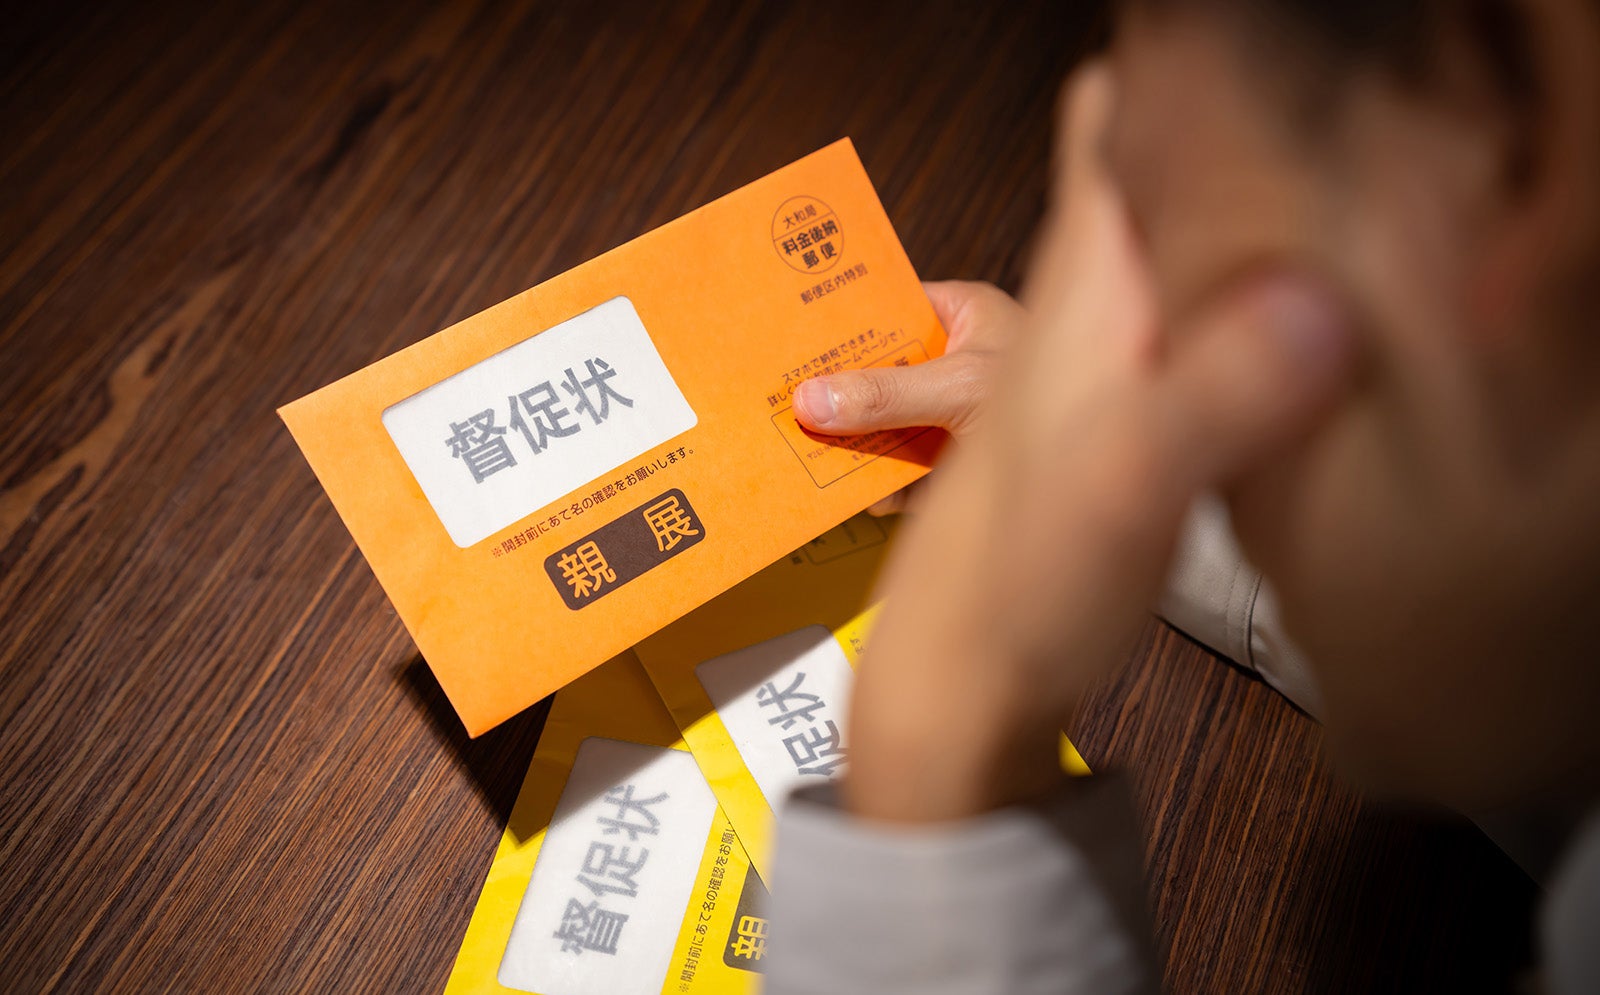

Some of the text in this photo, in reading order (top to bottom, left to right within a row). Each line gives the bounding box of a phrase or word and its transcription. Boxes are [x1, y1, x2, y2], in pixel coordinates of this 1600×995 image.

[781, 219, 839, 257] 料金後納
[782, 204, 817, 230] 大和局
[800, 262, 868, 305] 郵便区内特別
[767, 328, 905, 408] 詳しく和市ホームページで！
[444, 357, 634, 484] 督促状
[491, 445, 695, 558] ※開封前にあて名の確認をお願いします。
[552, 784, 671, 956] 督促状
